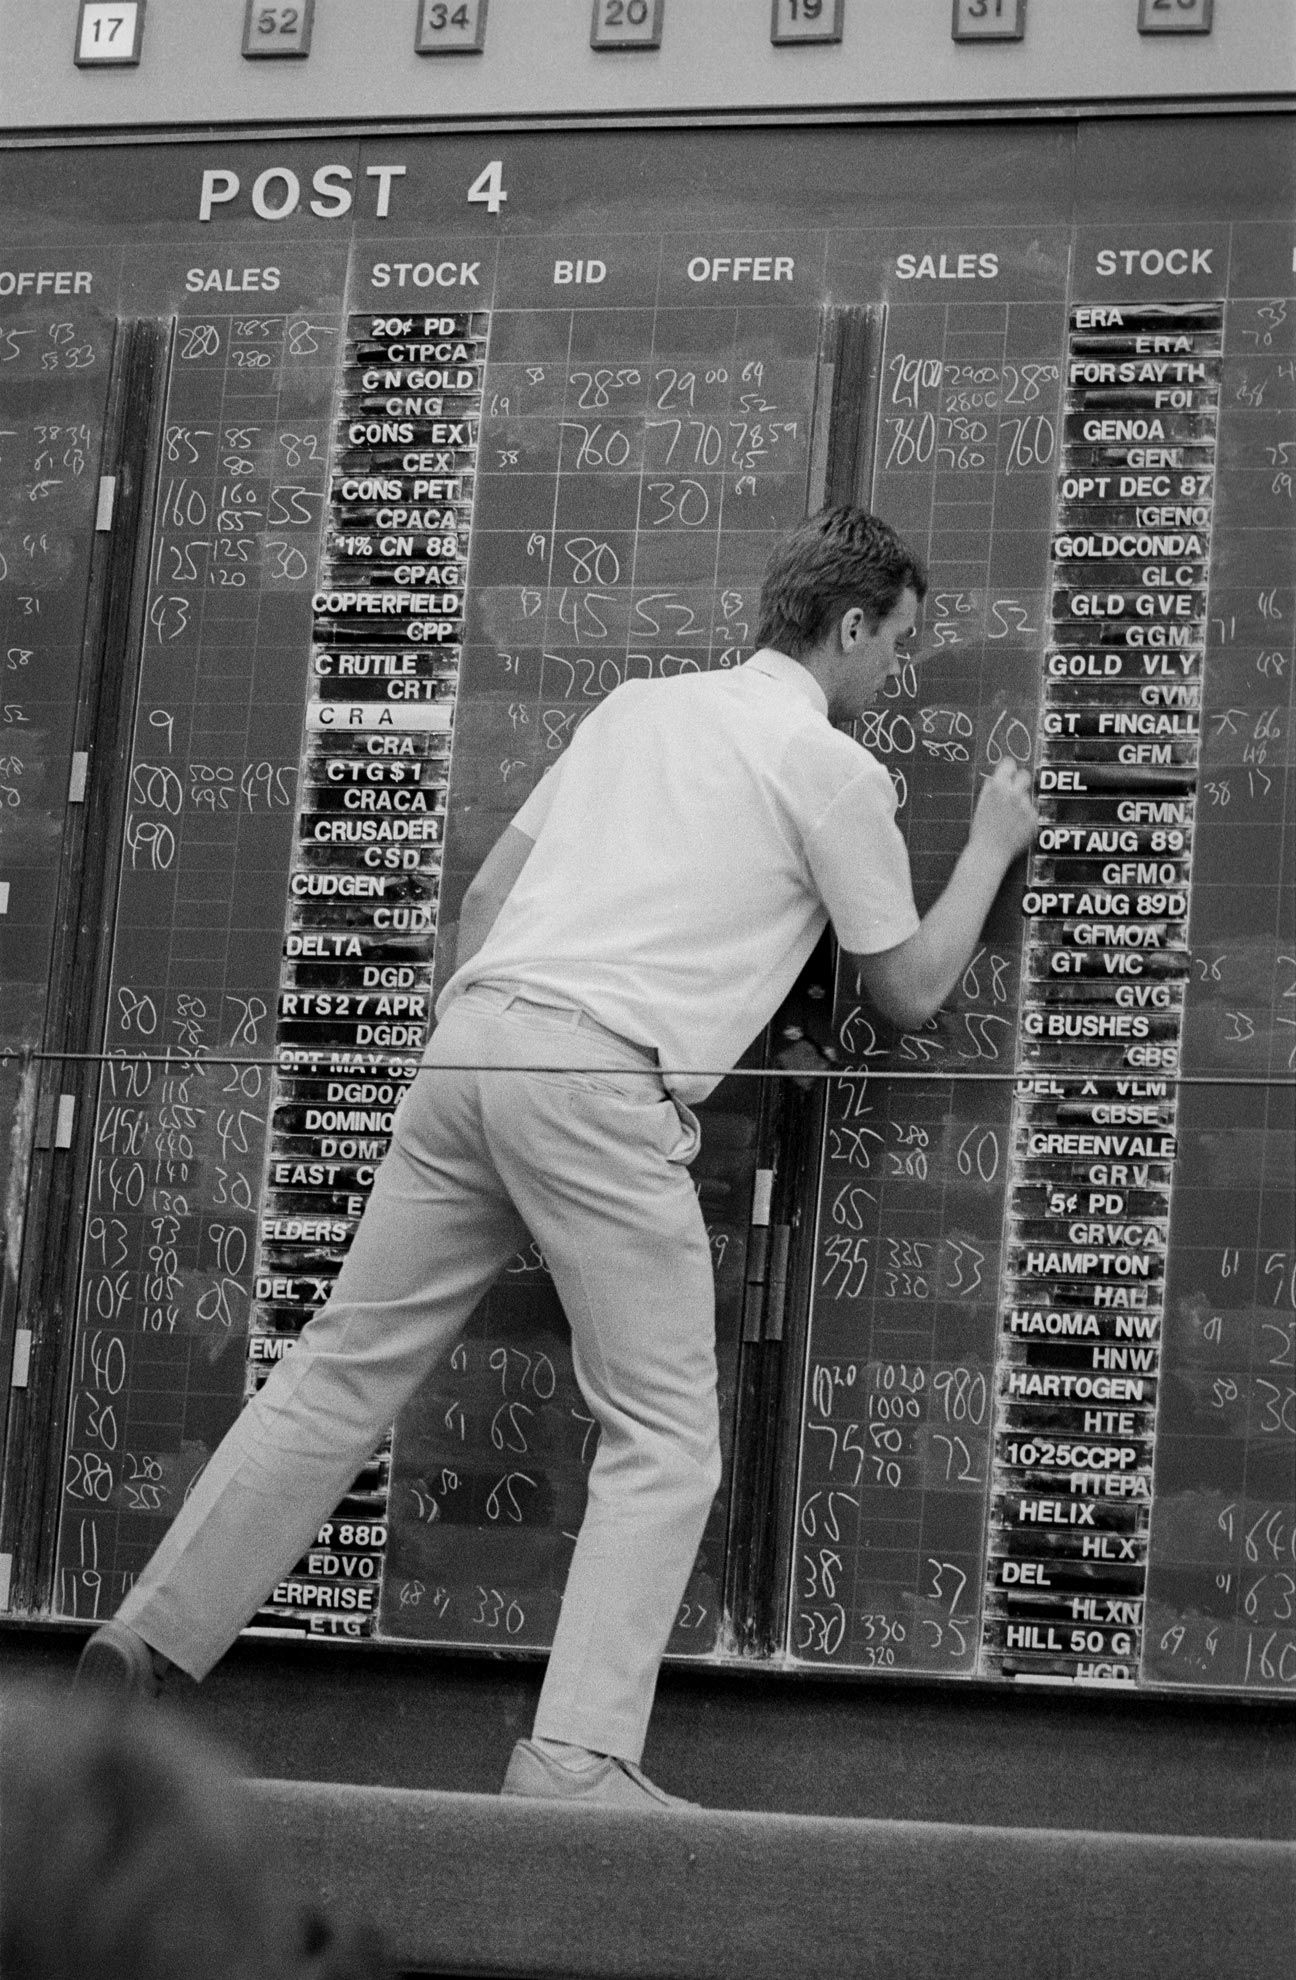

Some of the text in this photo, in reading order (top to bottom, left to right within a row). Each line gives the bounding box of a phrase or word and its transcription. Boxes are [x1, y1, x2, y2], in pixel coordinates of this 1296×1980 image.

[258, 8, 299, 35] 52
[429, 3, 470, 29] 34
[91, 17, 125, 43] 17
[199, 161, 508, 221] POST 4
[553, 260, 607, 285] BID
[687, 257, 795, 282] OFFER
[896, 253, 998, 280] SALES
[1096, 249, 1213, 276] STOCK
[0, 271, 93, 296] OFFER
[185, 267, 281, 293] SALES
[371, 262, 480, 288] STOCK
[424, 318, 456, 335] PD
[1076, 308, 1123, 328] ERA
[387, 344, 468, 362] CTPCA
[1135, 336, 1191, 354] ERA
[1070, 363, 1205, 384] FORSAYTH
[386, 398, 443, 416] CNG
[1155, 389, 1192, 408] FOI
[349, 424, 464, 444] CONS EX
[1083, 420, 1165, 441] GENOA
[402, 454, 451, 472] CEX
[1127, 449, 1177, 468] GEN
[342, 480, 459, 500] CONS PET
[1062, 476, 1211, 499] OPT DEC 87
[648, 479, 709, 525] 30
[376, 509, 458, 529] CPACA
[380, 536, 414, 556] CN
[426, 537, 458, 557] 88
[1054, 535, 1202, 557] GOLDCONDA
[565, 537, 620, 585] 80
[394, 566, 459, 585] CPAG
[1142, 566, 1194, 586] GLC
[312, 593, 459, 614] COPPERFIELD
[1071, 594, 1192, 616] GLD GVE
[988, 600, 1038, 638] 52
[407, 622, 453, 641] CPP
[1125, 626, 1190, 647] GGM
[315, 655, 418, 675] C RUTILE
[1049, 654, 1195, 676] GOLD VLY
[387, 680, 437, 700] CRT
[1141, 686, 1199, 706] GVM
[1044, 712, 1200, 735] GT FINGALL
[367, 737, 415, 756] CRA
[1118, 744, 1172, 765] GFM
[1039, 770, 1088, 792] DEL
[344, 790, 428, 812] CRACA
[1117, 801, 1185, 823] GFMN
[314, 821, 438, 841] CRUSADER
[1151, 830, 1184, 852] 89
[364, 849, 420, 869] CSD
[291, 876, 385, 897] CUDGEN
[1136, 893, 1186, 916] 89D
[373, 909, 429, 930] CUD
[1073, 923, 1161, 948] GFMOA
[286, 937, 362, 957] DELTA
[1051, 952, 1144, 975] GT VIC
[363, 968, 415, 988] DGD
[375, 997, 424, 1017] APR
[1115, 985, 1170, 1008] GVG
[356, 1025, 423, 1047] DGDR
[1024, 1014, 1150, 1038] G BUSHES
[279, 1051, 324, 1072] OPT
[330, 1053, 383, 1074] MAY
[1127, 1046, 1179, 1068] GBS
[1017, 1074, 1065, 1094] DEL
[1092, 1105, 1160, 1126] GBSE
[321, 1139, 378, 1160] DOM
[1029, 1133, 1177, 1158] GREENVALE
[275, 1164, 340, 1185] EAST
[1089, 1164, 1149, 1187] GRV
[1089, 1193, 1124, 1215] PD
[262, 1220, 347, 1241] ELDERS
[1069, 1222, 1160, 1248] GRVCA
[1027, 1252, 1150, 1276] HAMPTON
[256, 1279, 299, 1300] DEL
[1011, 1311, 1158, 1339] HAOMA NW
[1092, 1347, 1154, 1371] HNW
[1009, 1373, 1144, 1401] HARTOGEN
[1084, 1410, 1136, 1435] HTE
[1070, 1472, 1150, 1499] HTEPA
[1019, 1500, 1096, 1526] HELIX
[339, 1525, 388, 1547] 88D
[1082, 1536, 1136, 1560] HLX
[1002, 1562, 1051, 1587] DEL
[1072, 1597, 1141, 1625] HLXN
[1007, 1625, 1132, 1655] HILL 50 G
